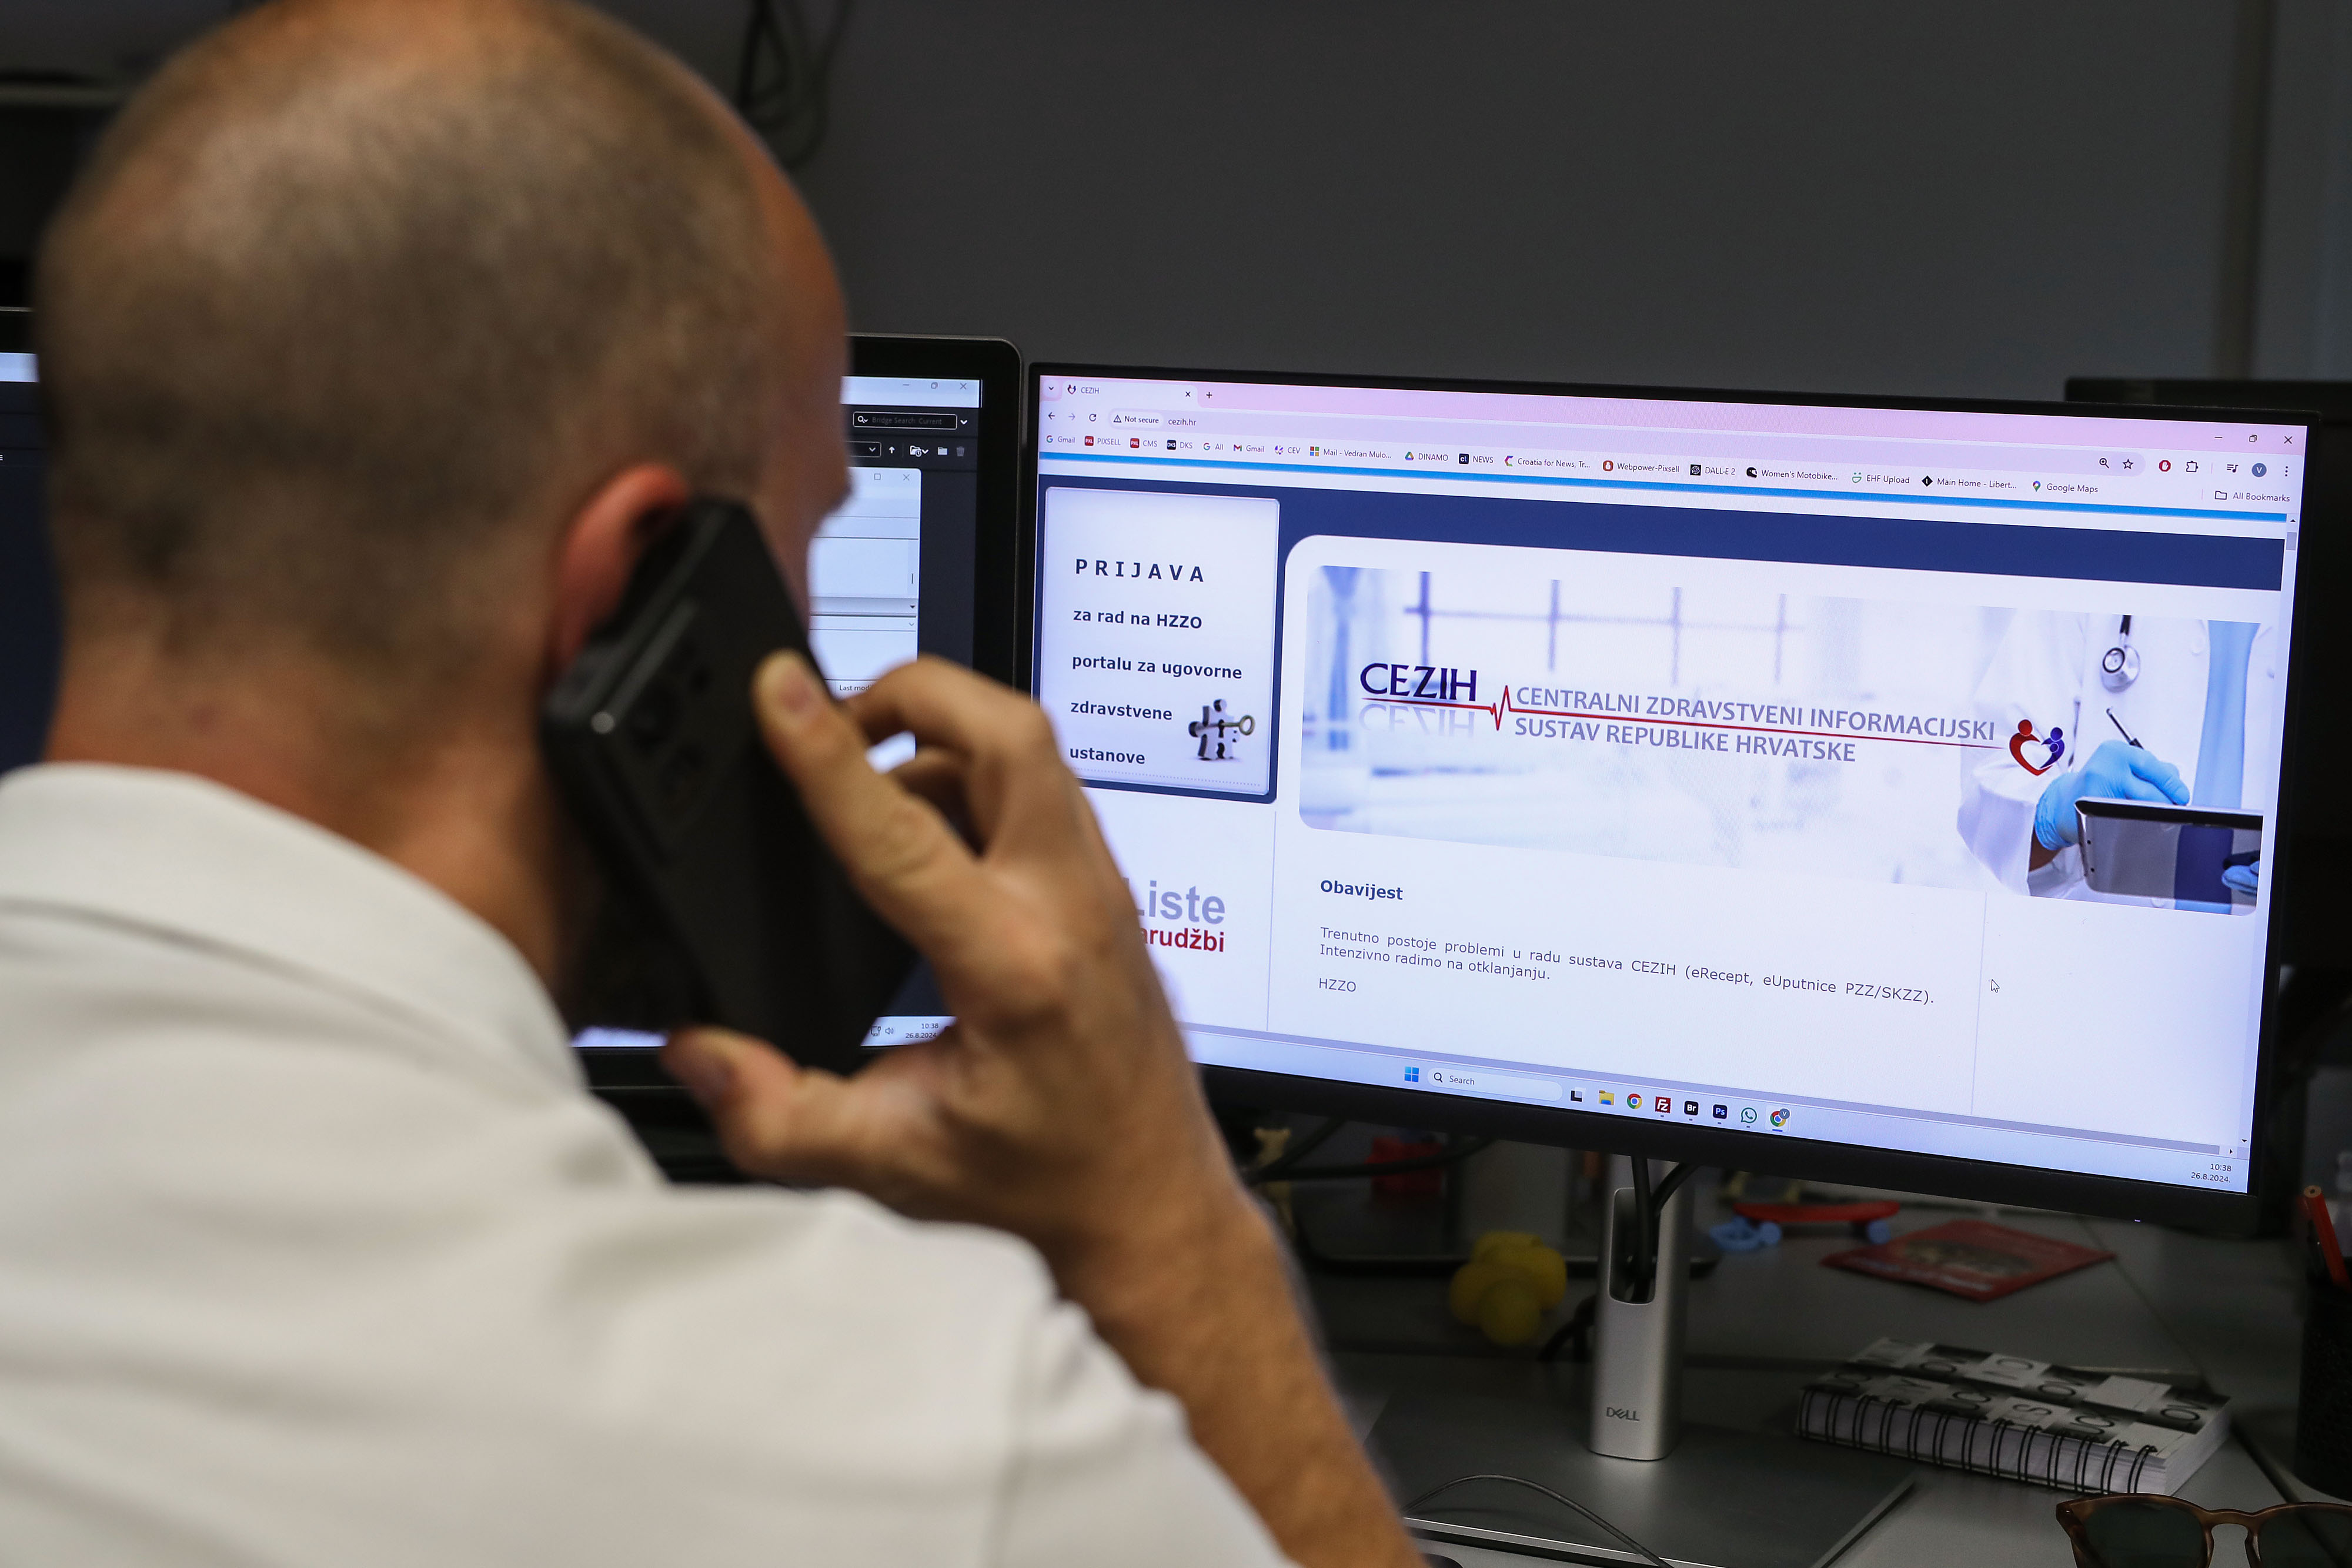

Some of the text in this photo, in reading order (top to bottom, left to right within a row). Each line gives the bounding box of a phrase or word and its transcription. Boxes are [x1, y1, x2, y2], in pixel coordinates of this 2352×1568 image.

[1556, 460, 1576, 468] News,
[1618, 463, 1679, 472] Webpower-Pixsell
[1762, 470, 1837, 480] Women's Motobike...
[1883, 476, 1909, 484] Upload
[2047, 483, 2098, 494] Google Maps
[2246, 493, 2290, 502] Bookmarks
[1074, 611, 1201, 628] za rad na HZZO
[1073, 657, 1241, 678] portalu za ugovorne
[1360, 663, 1477, 701] CEZIH
[1071, 701, 1172, 720] zdravstvene
[1516, 687, 1995, 741] CENTRALNI ZDRAVSTVENI INFORMACIJSKI
[1515, 718, 1856, 761] SUSTAV REPUBLIKE HRVATSKE
[1070, 748, 1145, 764] ustanove
[1321, 880, 1403, 900] Obavijest
[1122, 877, 1225, 925] iste
[1321, 944, 1549, 980] Intenzivno radimo na otklanjanju.
[1321, 927, 1933, 1005] Trenutno postoje problemi u radu sustava CEZIH (eRecept, eUputnice PZZ/SKZZ).
[1319, 978, 1356, 992] HZZO
[1449, 1075, 1474, 1085] Search
[2191, 1172, 2230, 1183] 26.8.2024.
[1606, 1407, 1639, 1421] DELL
